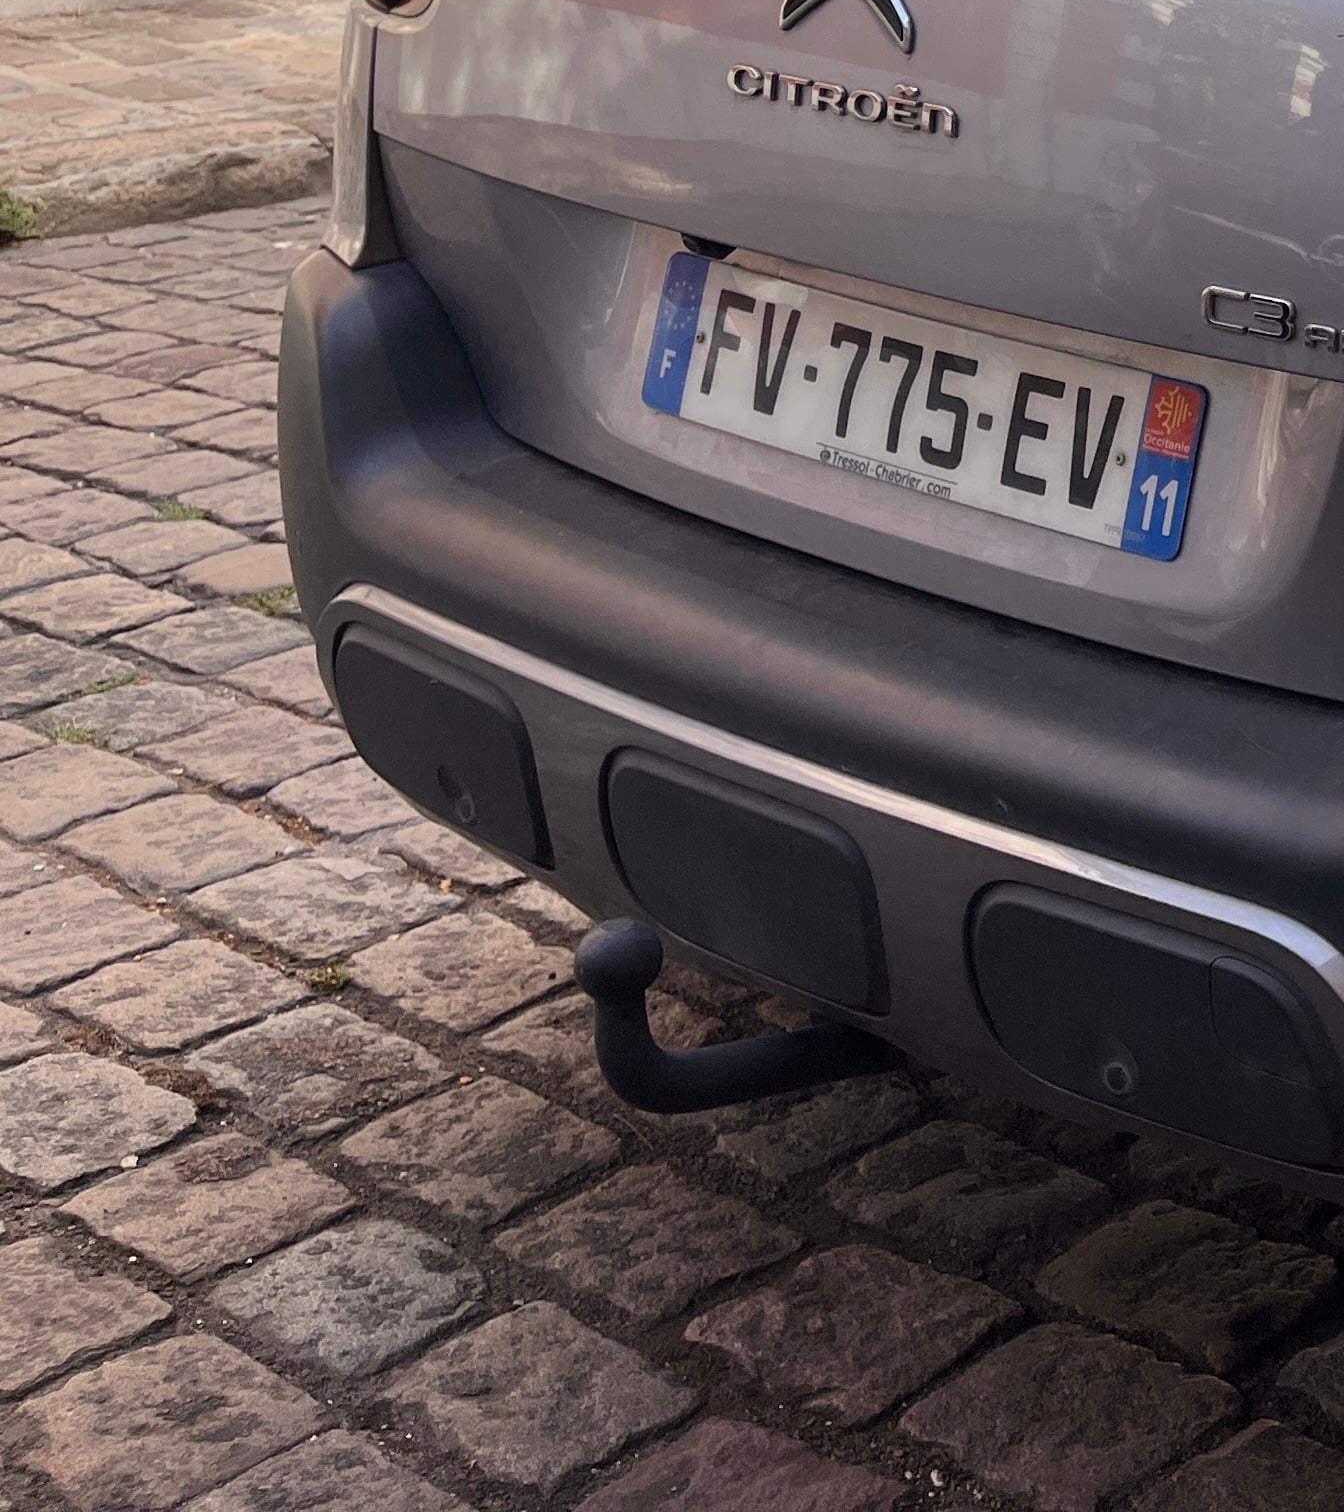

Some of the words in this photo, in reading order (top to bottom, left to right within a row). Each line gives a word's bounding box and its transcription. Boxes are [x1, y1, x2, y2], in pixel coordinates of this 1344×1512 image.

[1201, 285, 1297, 341] C3
[659, 349, 676, 378] F
[1143, 431, 1190, 454] Occitanie
[1139, 474, 1179, 537] 11
